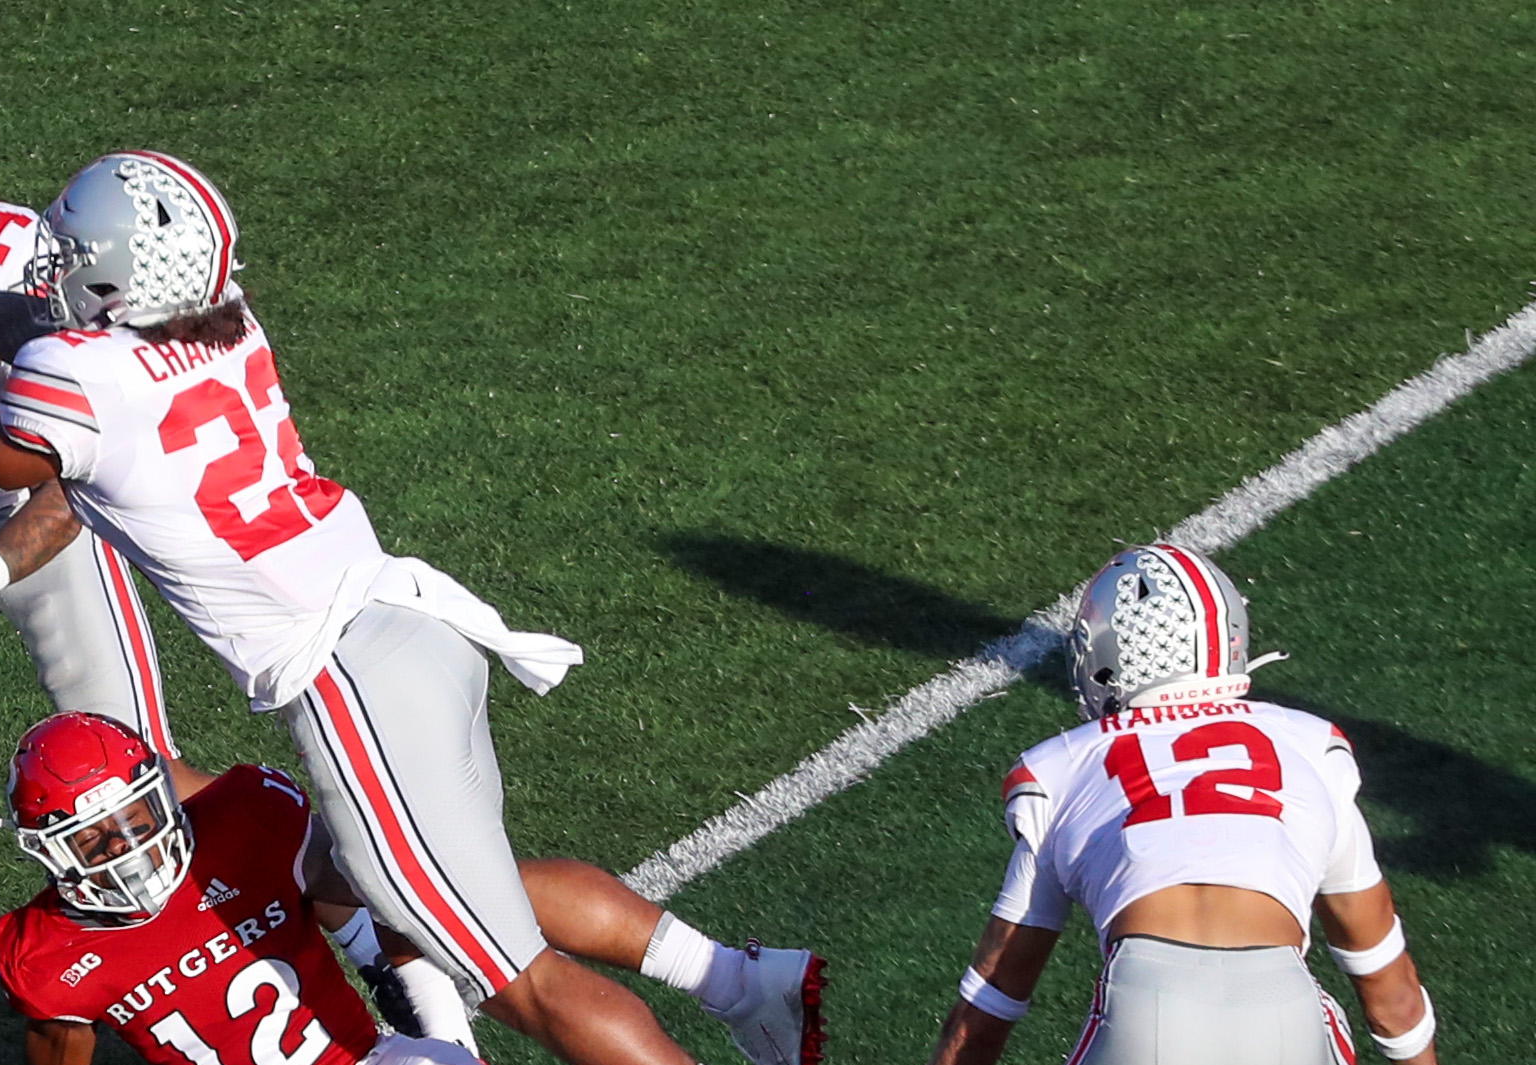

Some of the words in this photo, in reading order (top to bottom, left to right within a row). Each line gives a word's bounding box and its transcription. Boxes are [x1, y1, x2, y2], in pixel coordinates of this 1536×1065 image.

[1103, 720, 1284, 829] 12
[197, 887, 240, 912] adidas
[105, 900, 287, 1026] RUTGERS
